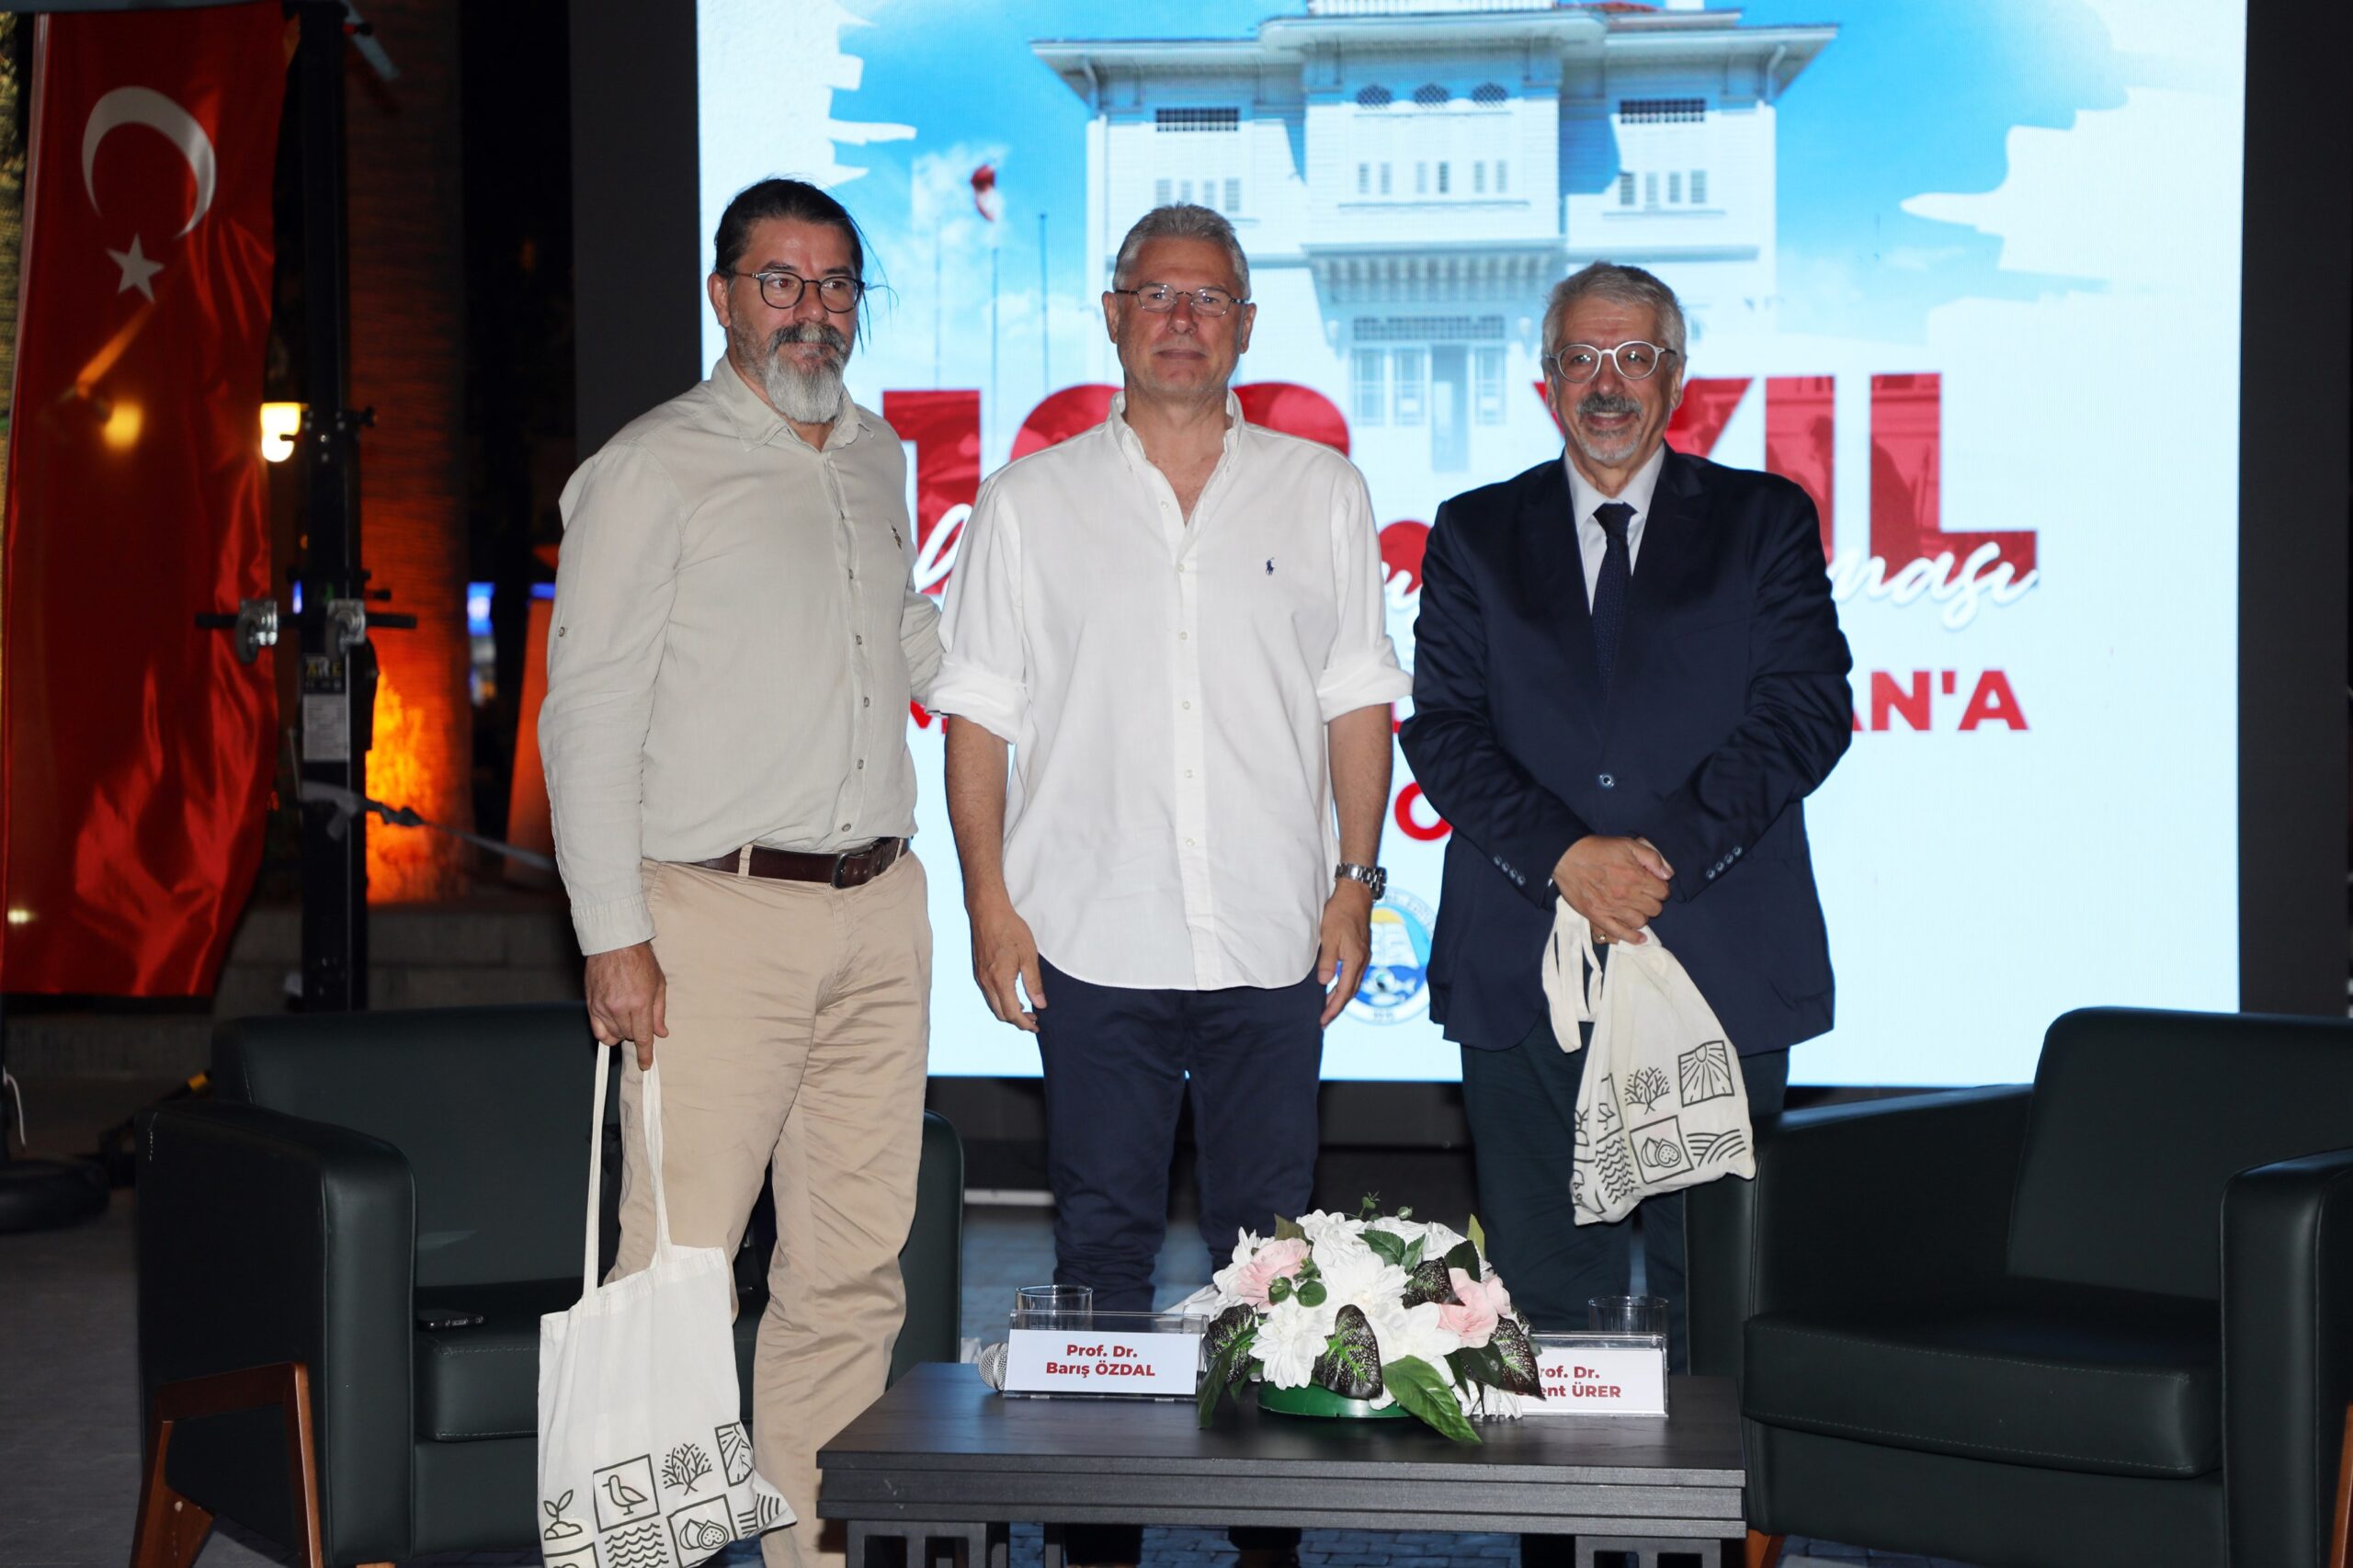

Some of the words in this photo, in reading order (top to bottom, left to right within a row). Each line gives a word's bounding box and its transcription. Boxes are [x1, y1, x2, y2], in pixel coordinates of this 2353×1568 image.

[1853, 670, 2030, 733] N'A
[1066, 1344, 1108, 1358] Prof.
[1112, 1345, 1138, 1358] Dr.
[1046, 1361, 1090, 1379] Barış
[1095, 1360, 1155, 1377] ÖZDAL
[1539, 1366, 1568, 1378] rof.
[1574, 1366, 1600, 1379] Dr.
[1572, 1381, 1621, 1398] ÜRER
